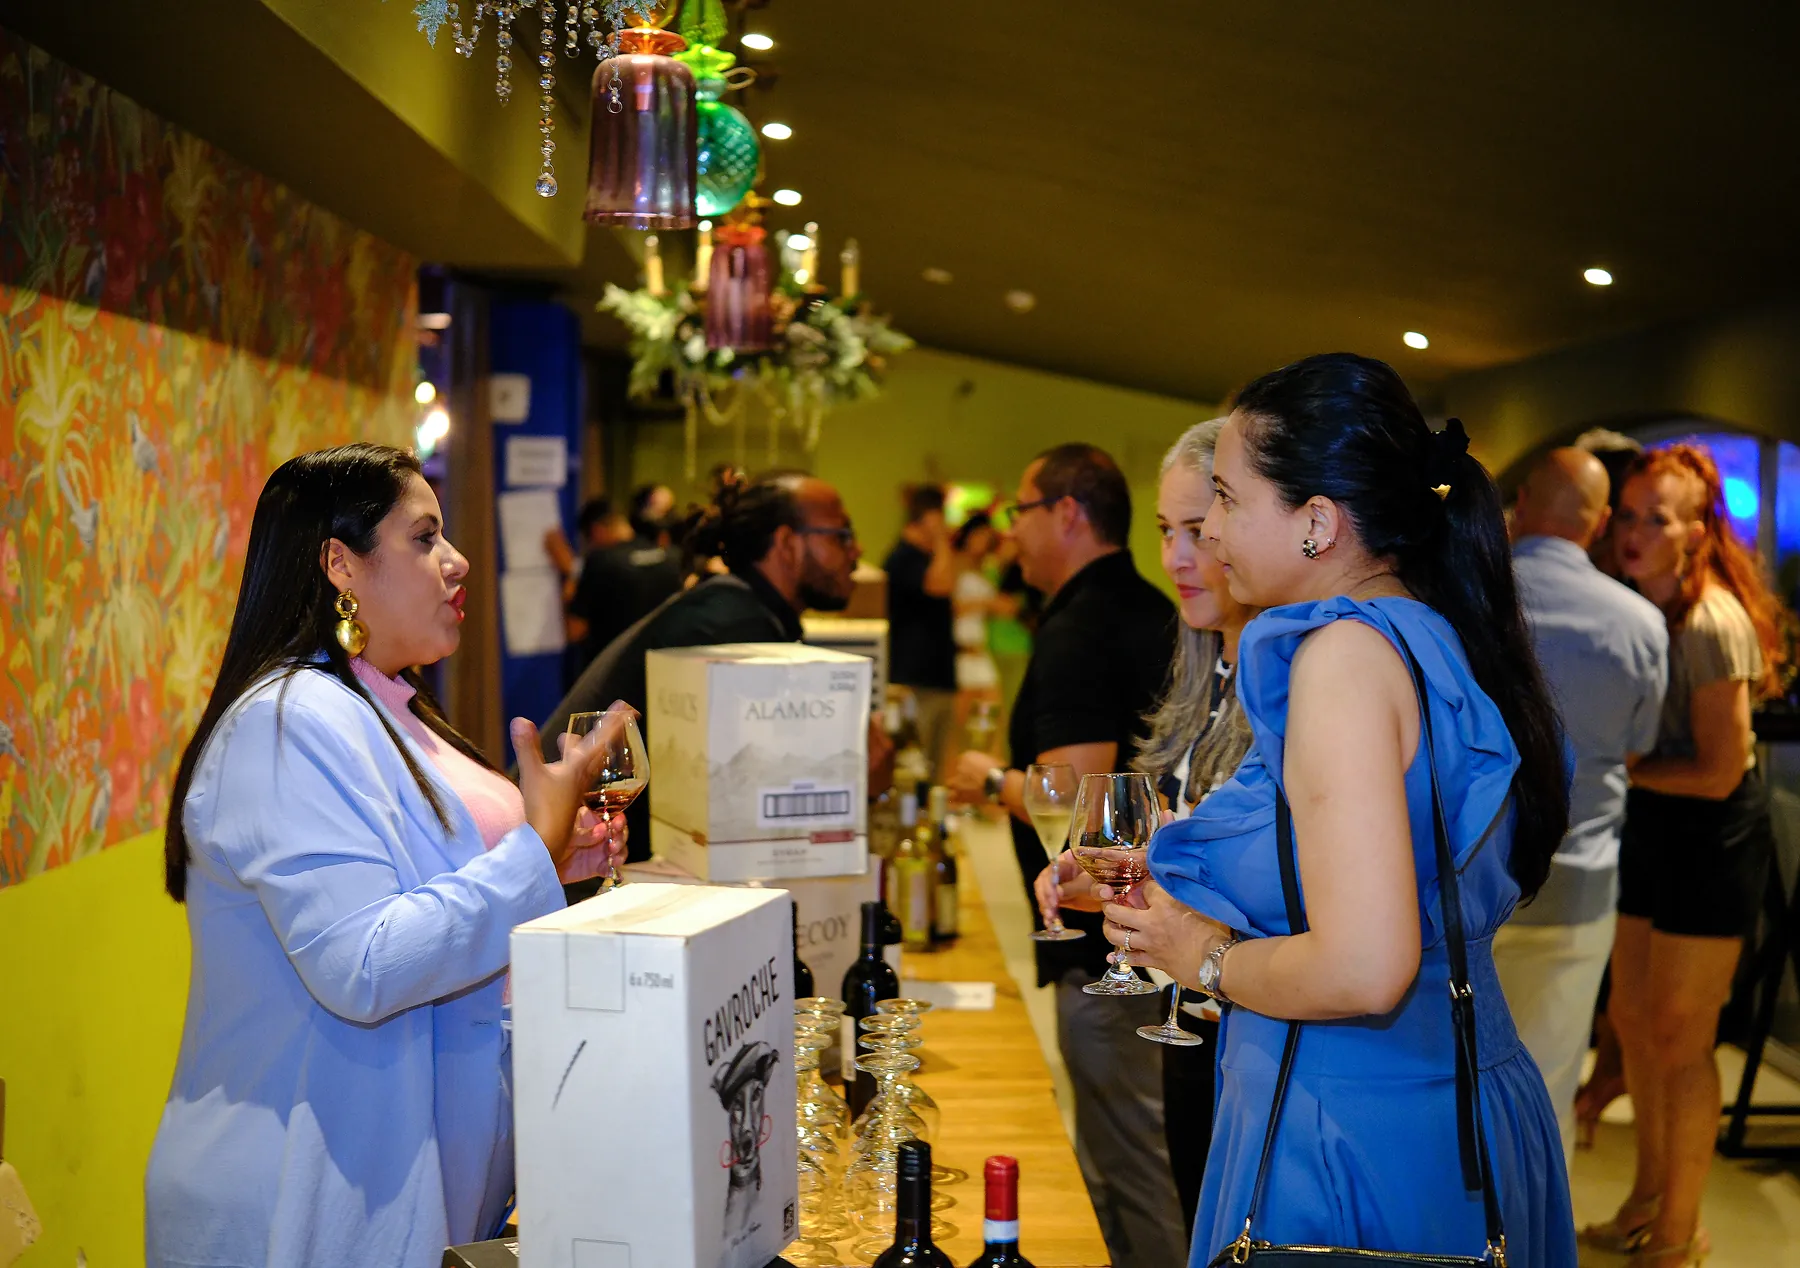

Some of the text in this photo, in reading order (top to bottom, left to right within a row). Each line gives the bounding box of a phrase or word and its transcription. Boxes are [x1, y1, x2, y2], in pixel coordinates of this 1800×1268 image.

[745, 700, 836, 721] ALAMOS
[796, 913, 852, 949] ECOY
[704, 956, 779, 1066] GAVROCHE
